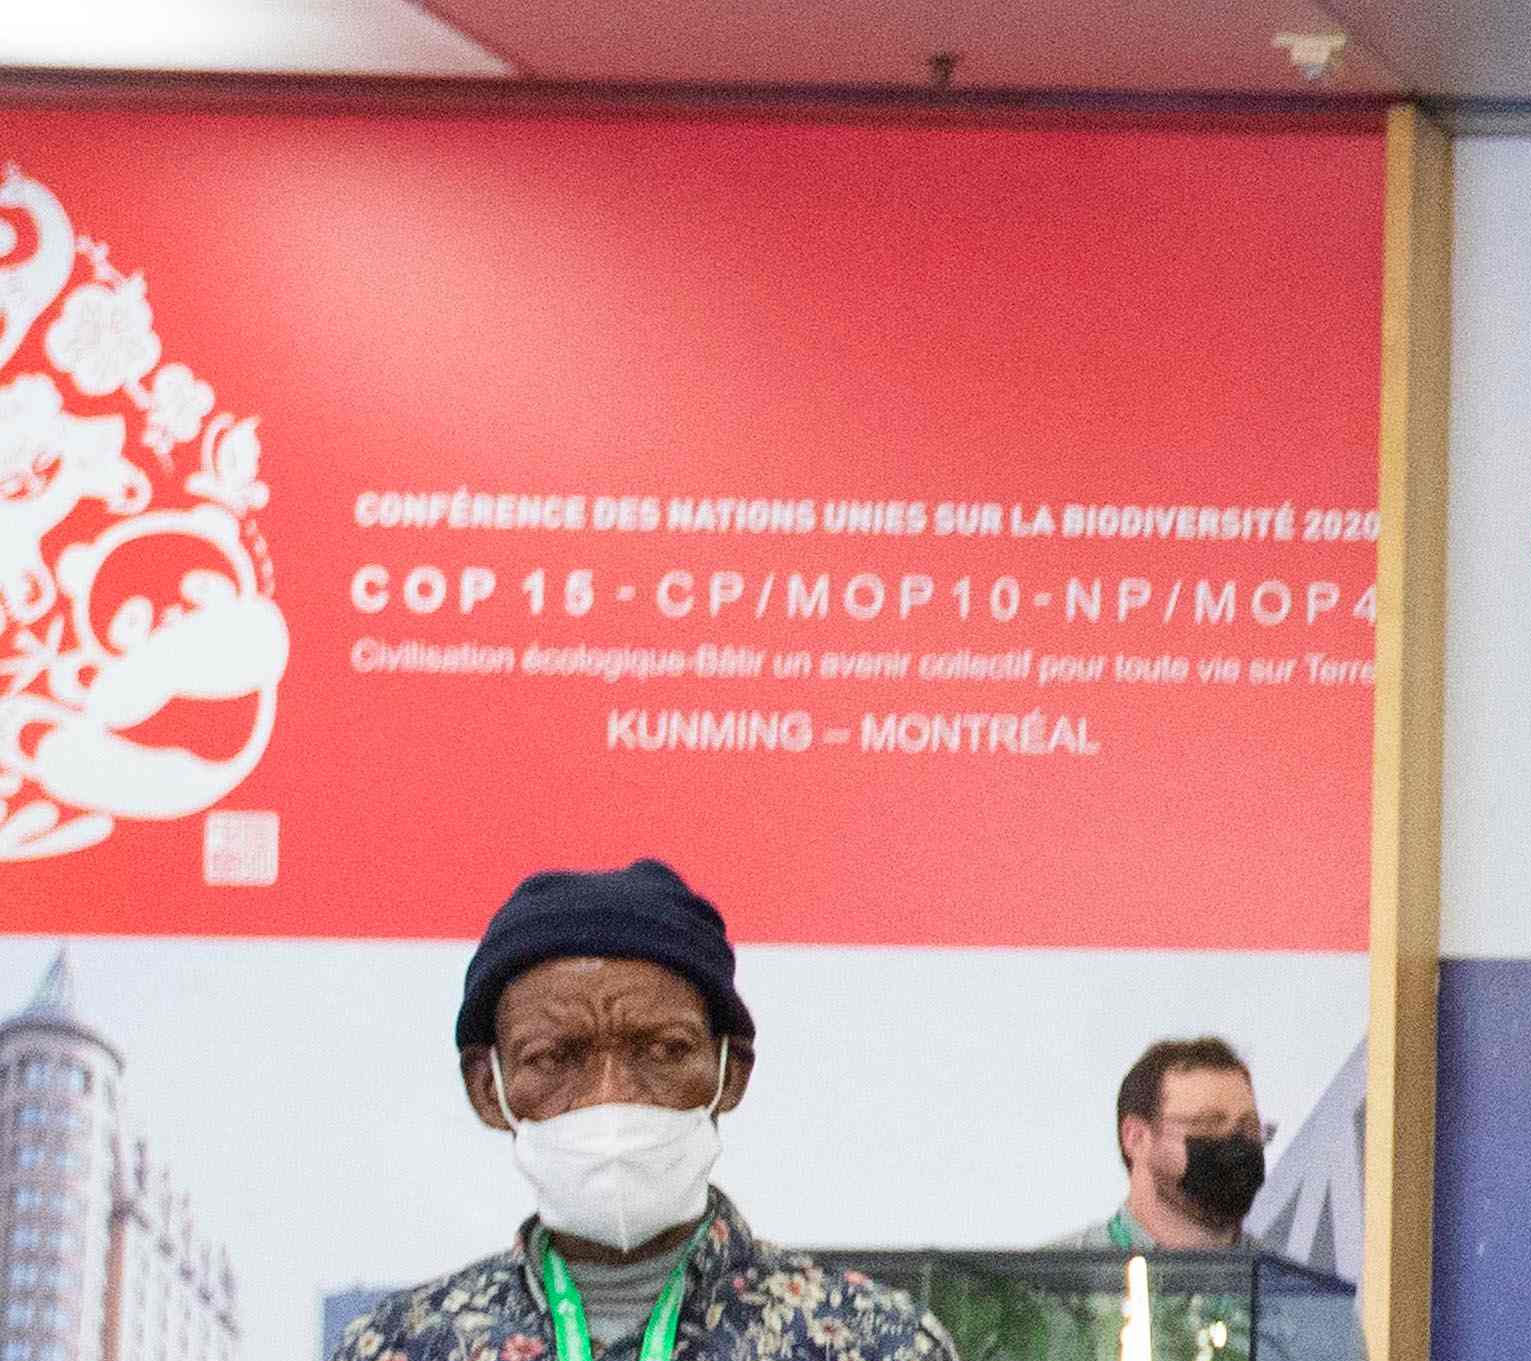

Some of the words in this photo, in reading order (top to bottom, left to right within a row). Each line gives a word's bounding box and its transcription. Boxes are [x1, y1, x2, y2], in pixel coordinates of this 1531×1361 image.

[355, 486, 587, 530] CONFÉRENCE
[592, 498, 661, 532] DES
[666, 499, 815, 535] NATIONS
[823, 501, 926, 536] UNIES
[934, 503, 1001, 537] SUR
[1009, 504, 1056, 539] LA
[1061, 503, 1296, 542] BIODIVERSITÉ
[1302, 508, 1381, 543] 2020
[351, 564, 498, 616] COP
[352, 637, 516, 674] Civilisation
[772, 651, 813, 679] un
[819, 651, 911, 680] avenir
[918, 647, 1033, 680] collectif
[1037, 653, 1107, 686] pour
[1114, 652, 1191, 684] toute
[1197, 654, 1242, 684] vie
[1249, 656, 1297, 684] sur
[1305, 652, 1376, 685] Terre
[607, 708, 814, 752] KUNMING
[860, 709, 1101, 755] MONTRÉAL
